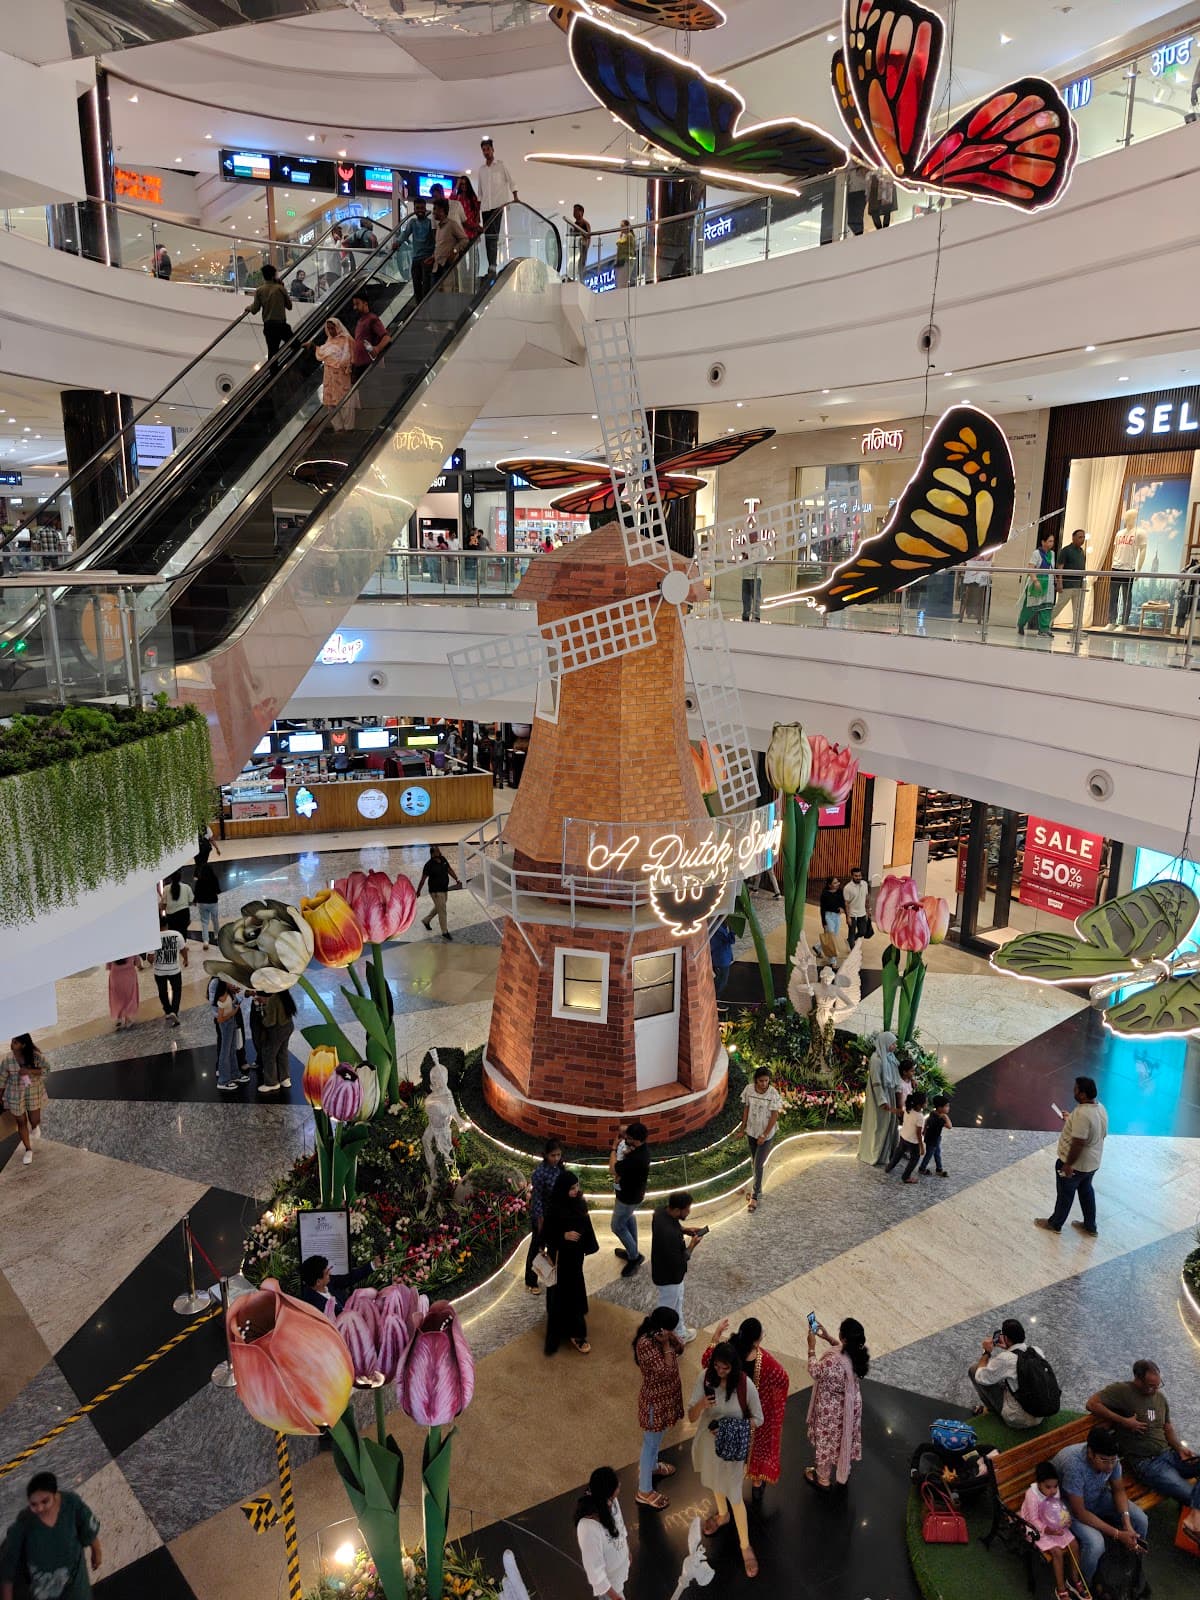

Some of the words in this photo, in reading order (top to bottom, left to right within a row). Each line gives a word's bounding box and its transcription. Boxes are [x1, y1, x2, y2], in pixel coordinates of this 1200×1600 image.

[342, 182, 351, 193] 1
[1125, 401, 1199, 436] SEL
[861, 427, 904, 455] तनिष्क
[334, 745, 346, 754] LG
[587, 835, 640, 872] A
[641, 829, 733, 872] Dutch
[1034, 826, 1095, 859] SALE
[1032, 855, 1042, 876] FLAT
[1040, 858, 1082, 885] 50%
[1067, 881, 1082, 889] OFF
